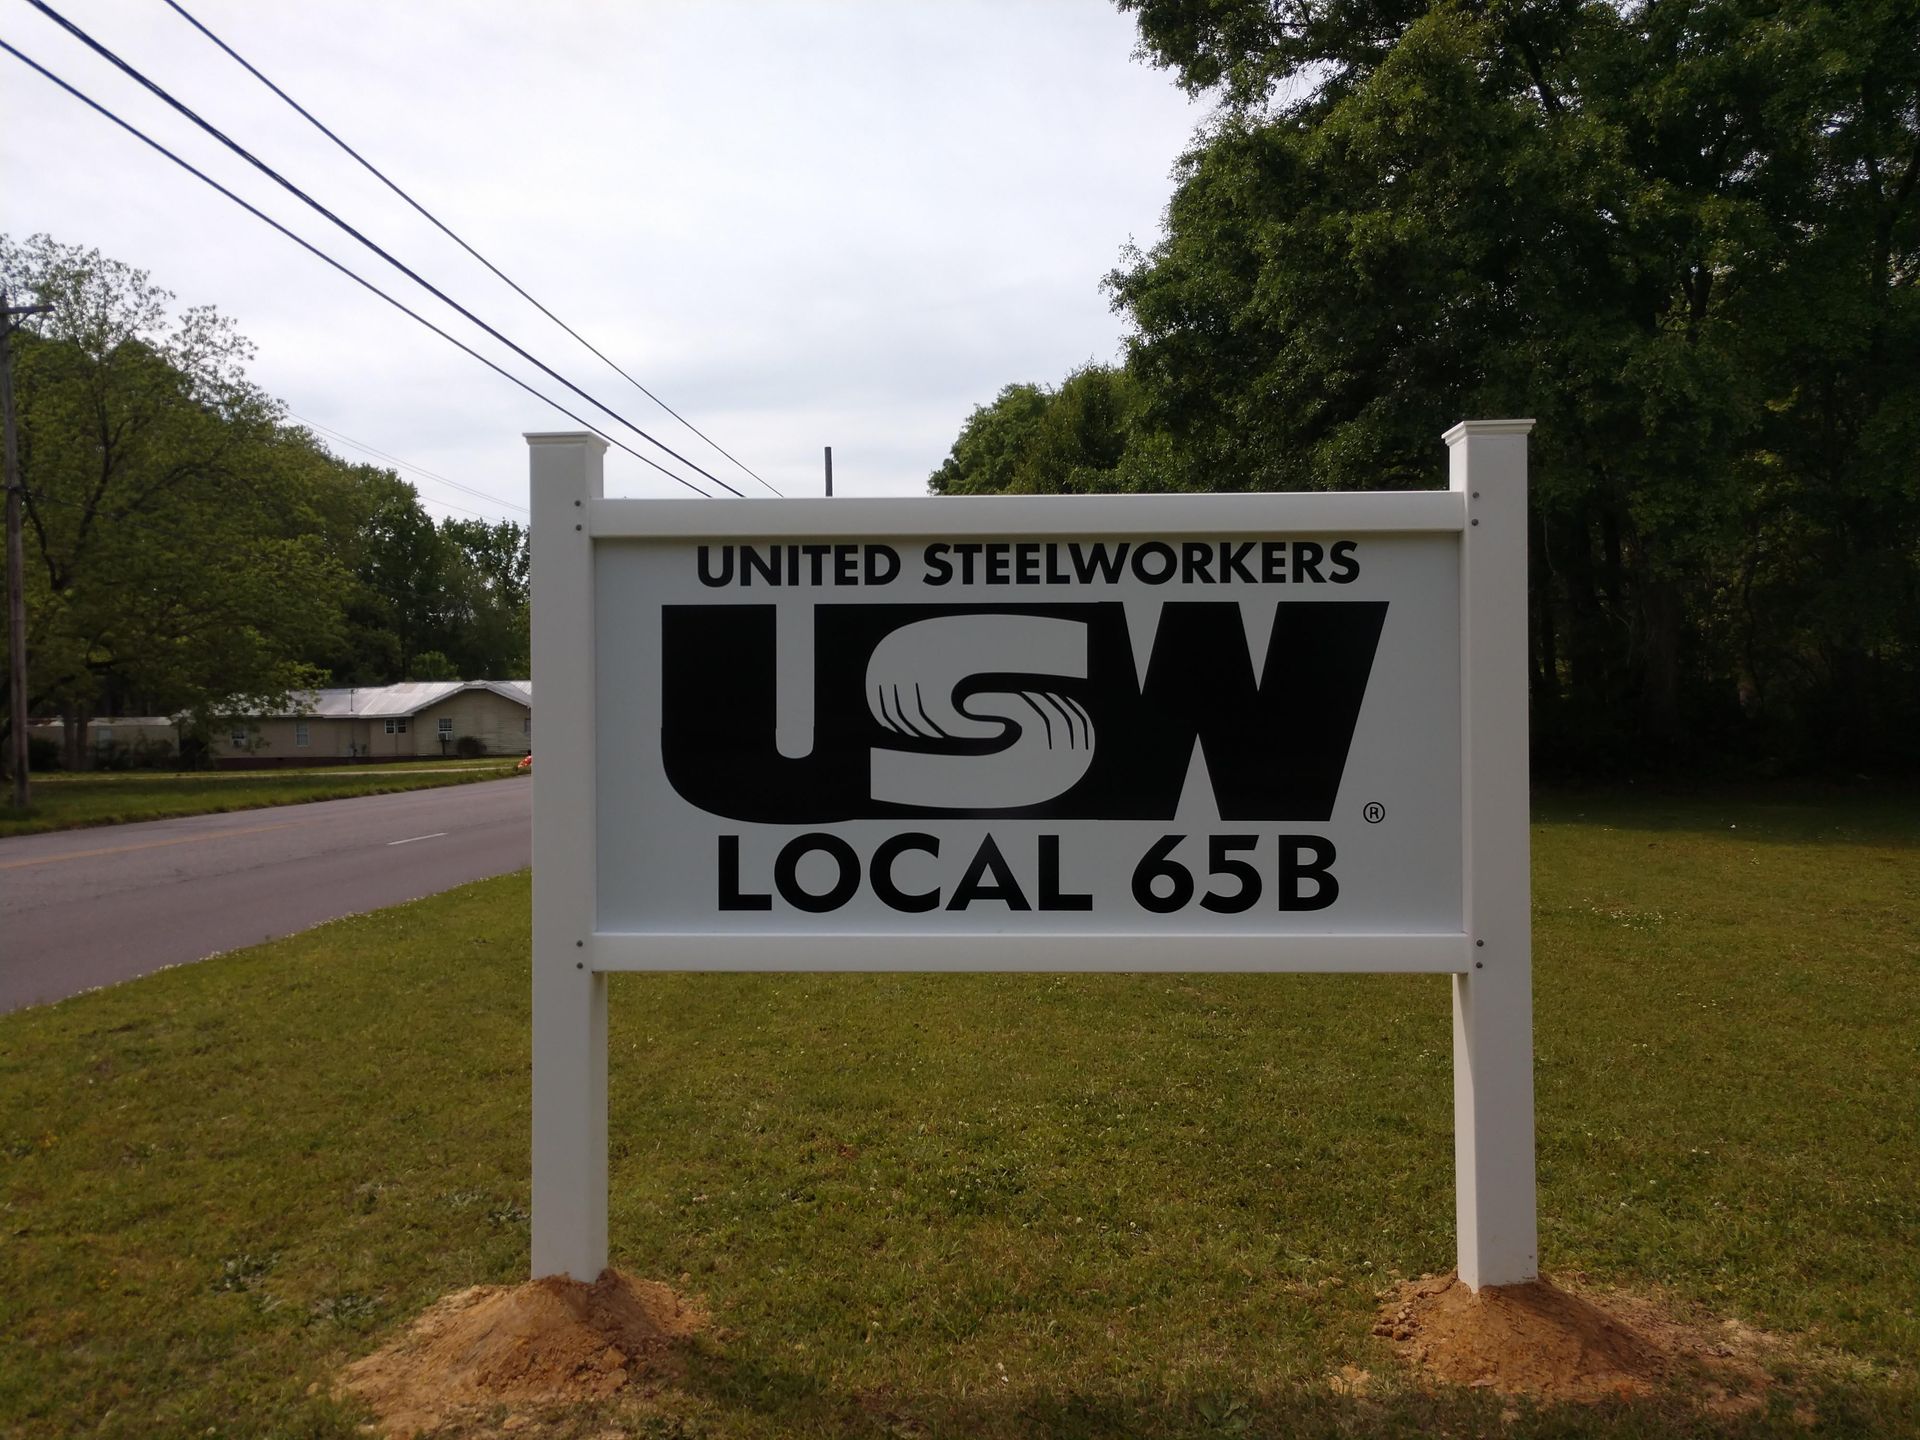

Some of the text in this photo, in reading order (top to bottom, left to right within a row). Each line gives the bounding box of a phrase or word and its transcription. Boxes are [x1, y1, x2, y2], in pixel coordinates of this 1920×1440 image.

[698, 541, 1360, 589] UNITED STEELWORKERS
[661, 601, 1390, 824] USW
[717, 832, 1340, 914] LOCAL 65B
